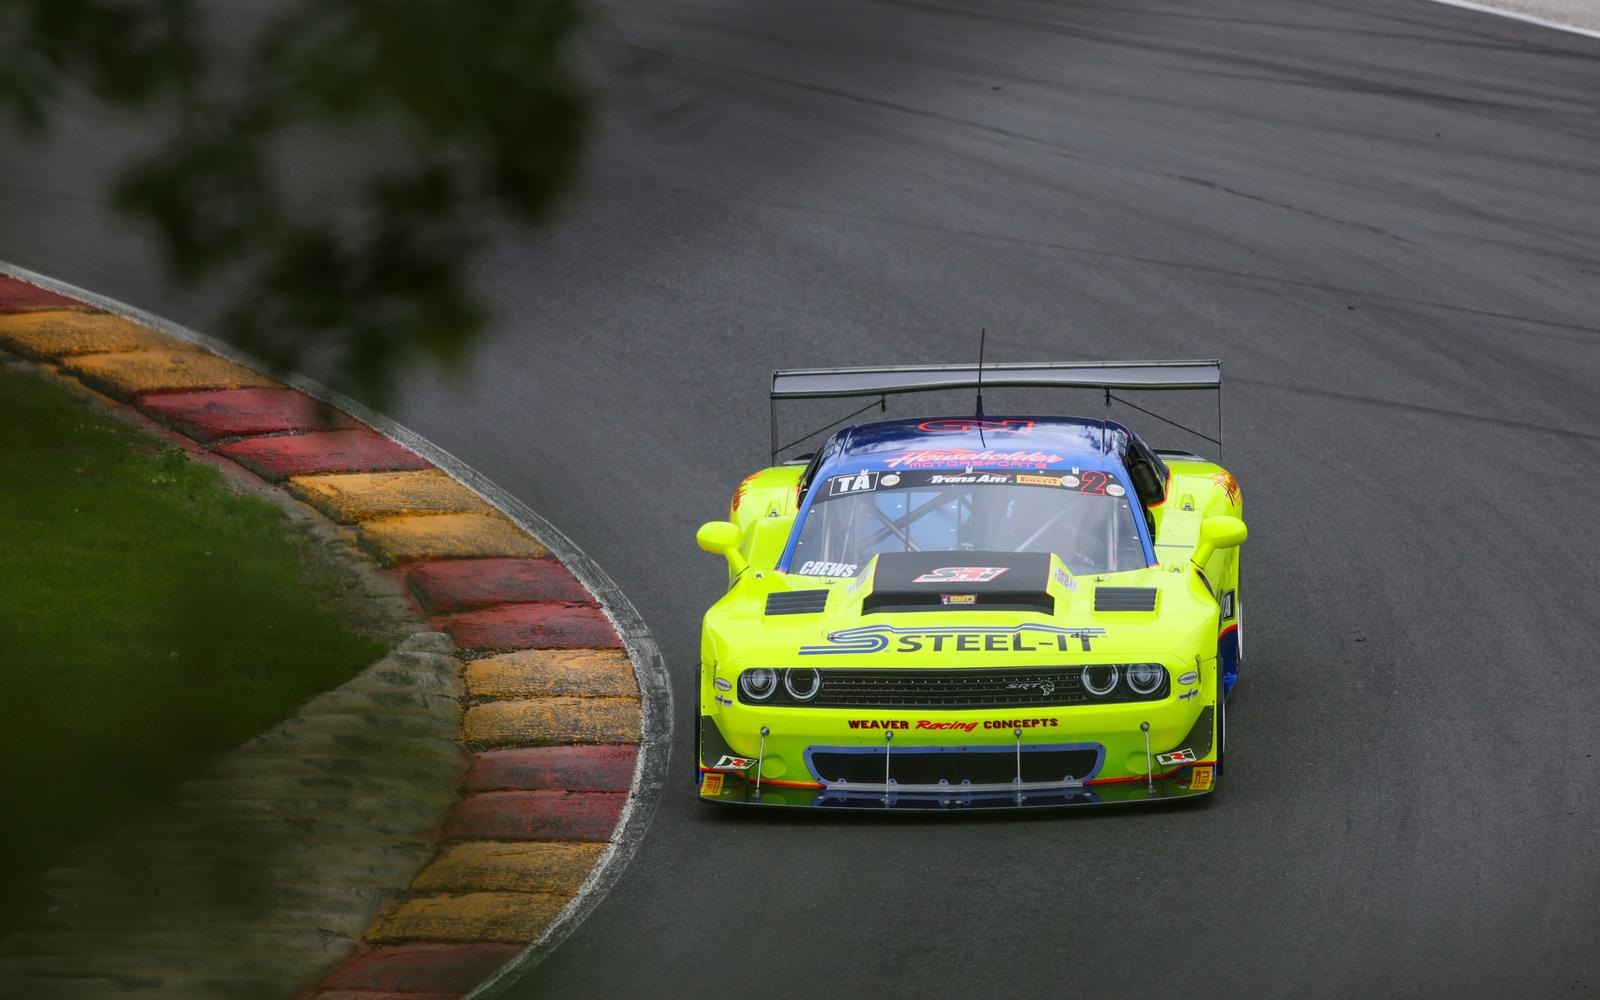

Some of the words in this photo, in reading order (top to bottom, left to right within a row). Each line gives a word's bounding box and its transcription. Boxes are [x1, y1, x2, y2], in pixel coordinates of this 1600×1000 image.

[838, 475, 870, 492] TA
[931, 475, 976, 484] Trans
[976, 475, 1008, 483] Am
[1080, 470, 1107, 497] 2
[799, 560, 857, 577] CREWS
[897, 633, 1098, 652] STEEL-IT
[848, 720, 909, 730] WEAVER
[915, 720, 979, 732] Racing
[983, 718, 1058, 729] CONCEPTS
